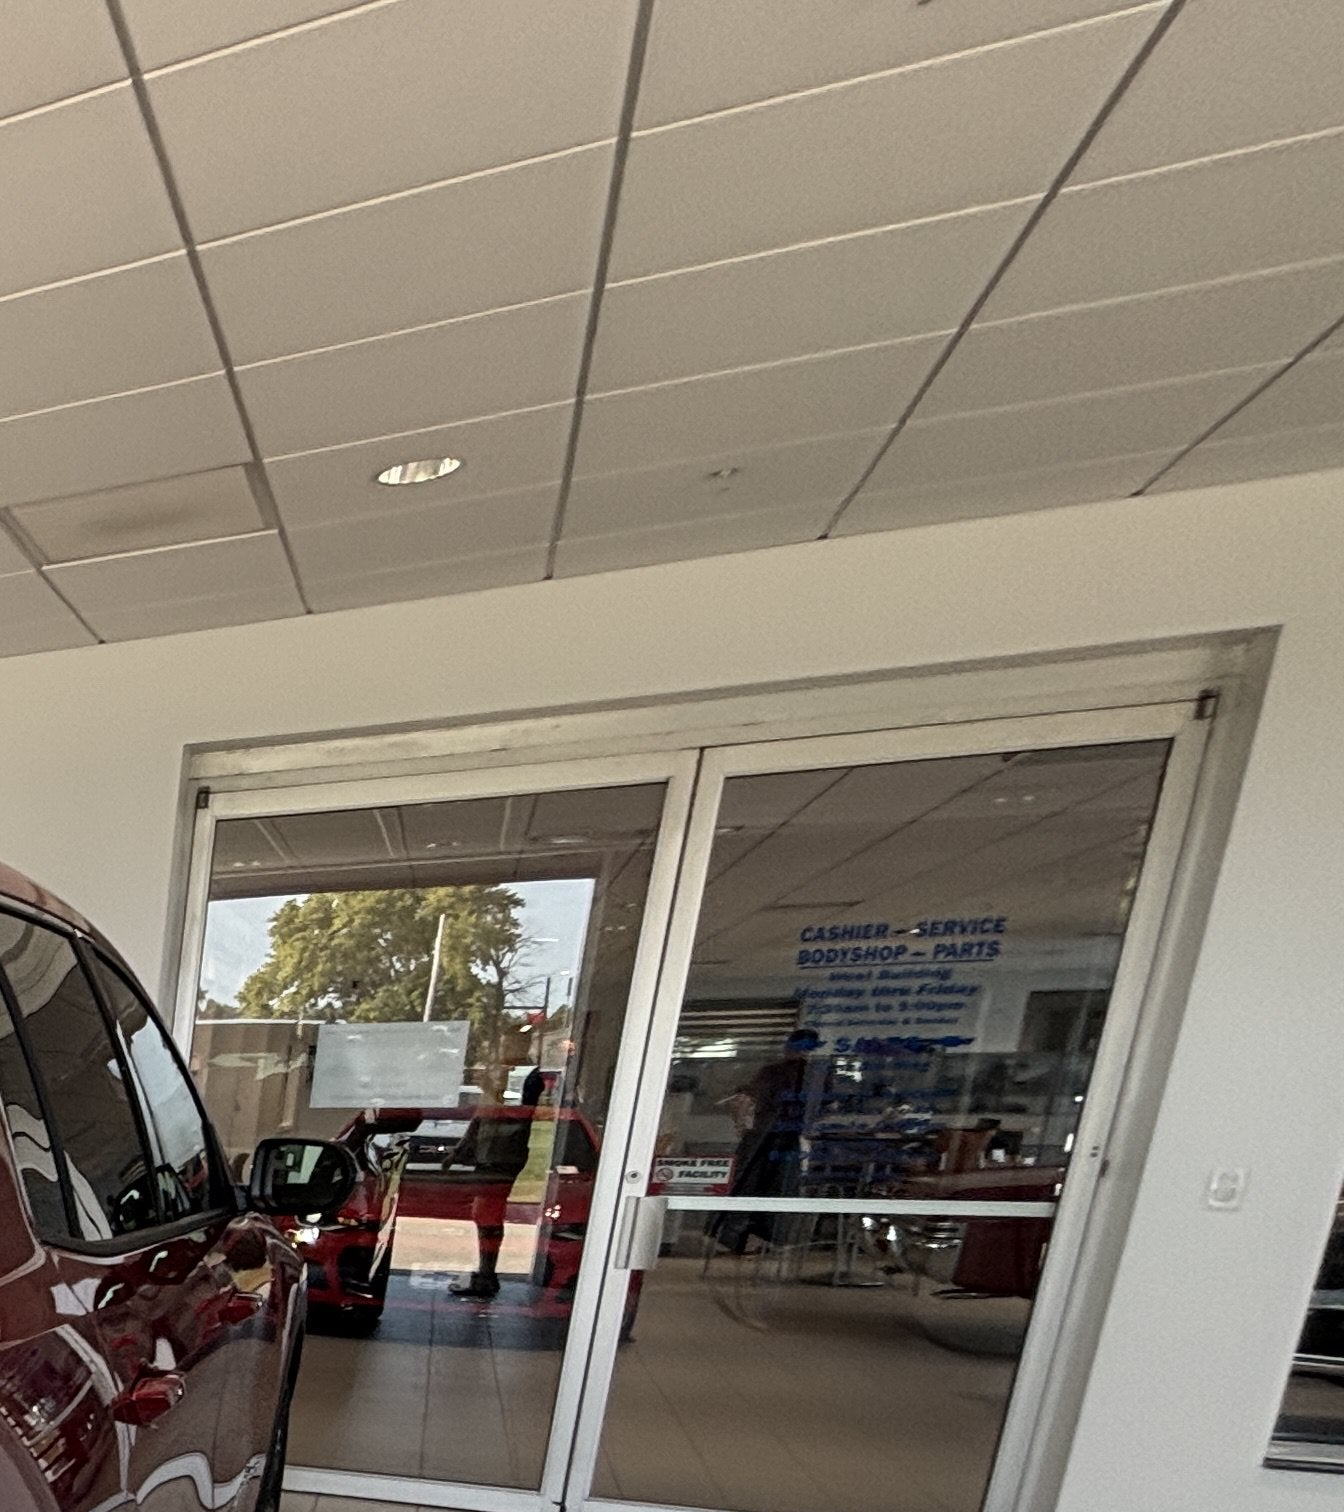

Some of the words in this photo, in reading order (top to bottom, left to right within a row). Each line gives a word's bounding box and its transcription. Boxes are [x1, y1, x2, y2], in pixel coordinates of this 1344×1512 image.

[800, 923, 889, 943] CASHIER
[916, 916, 1007, 938] SERVICE
[797, 944, 909, 966] BODYSHOP
[932, 940, 1002, 960] PARTS
[915, 983, 981, 997] Friday
[678, 1170, 728, 1178] FACILITY
